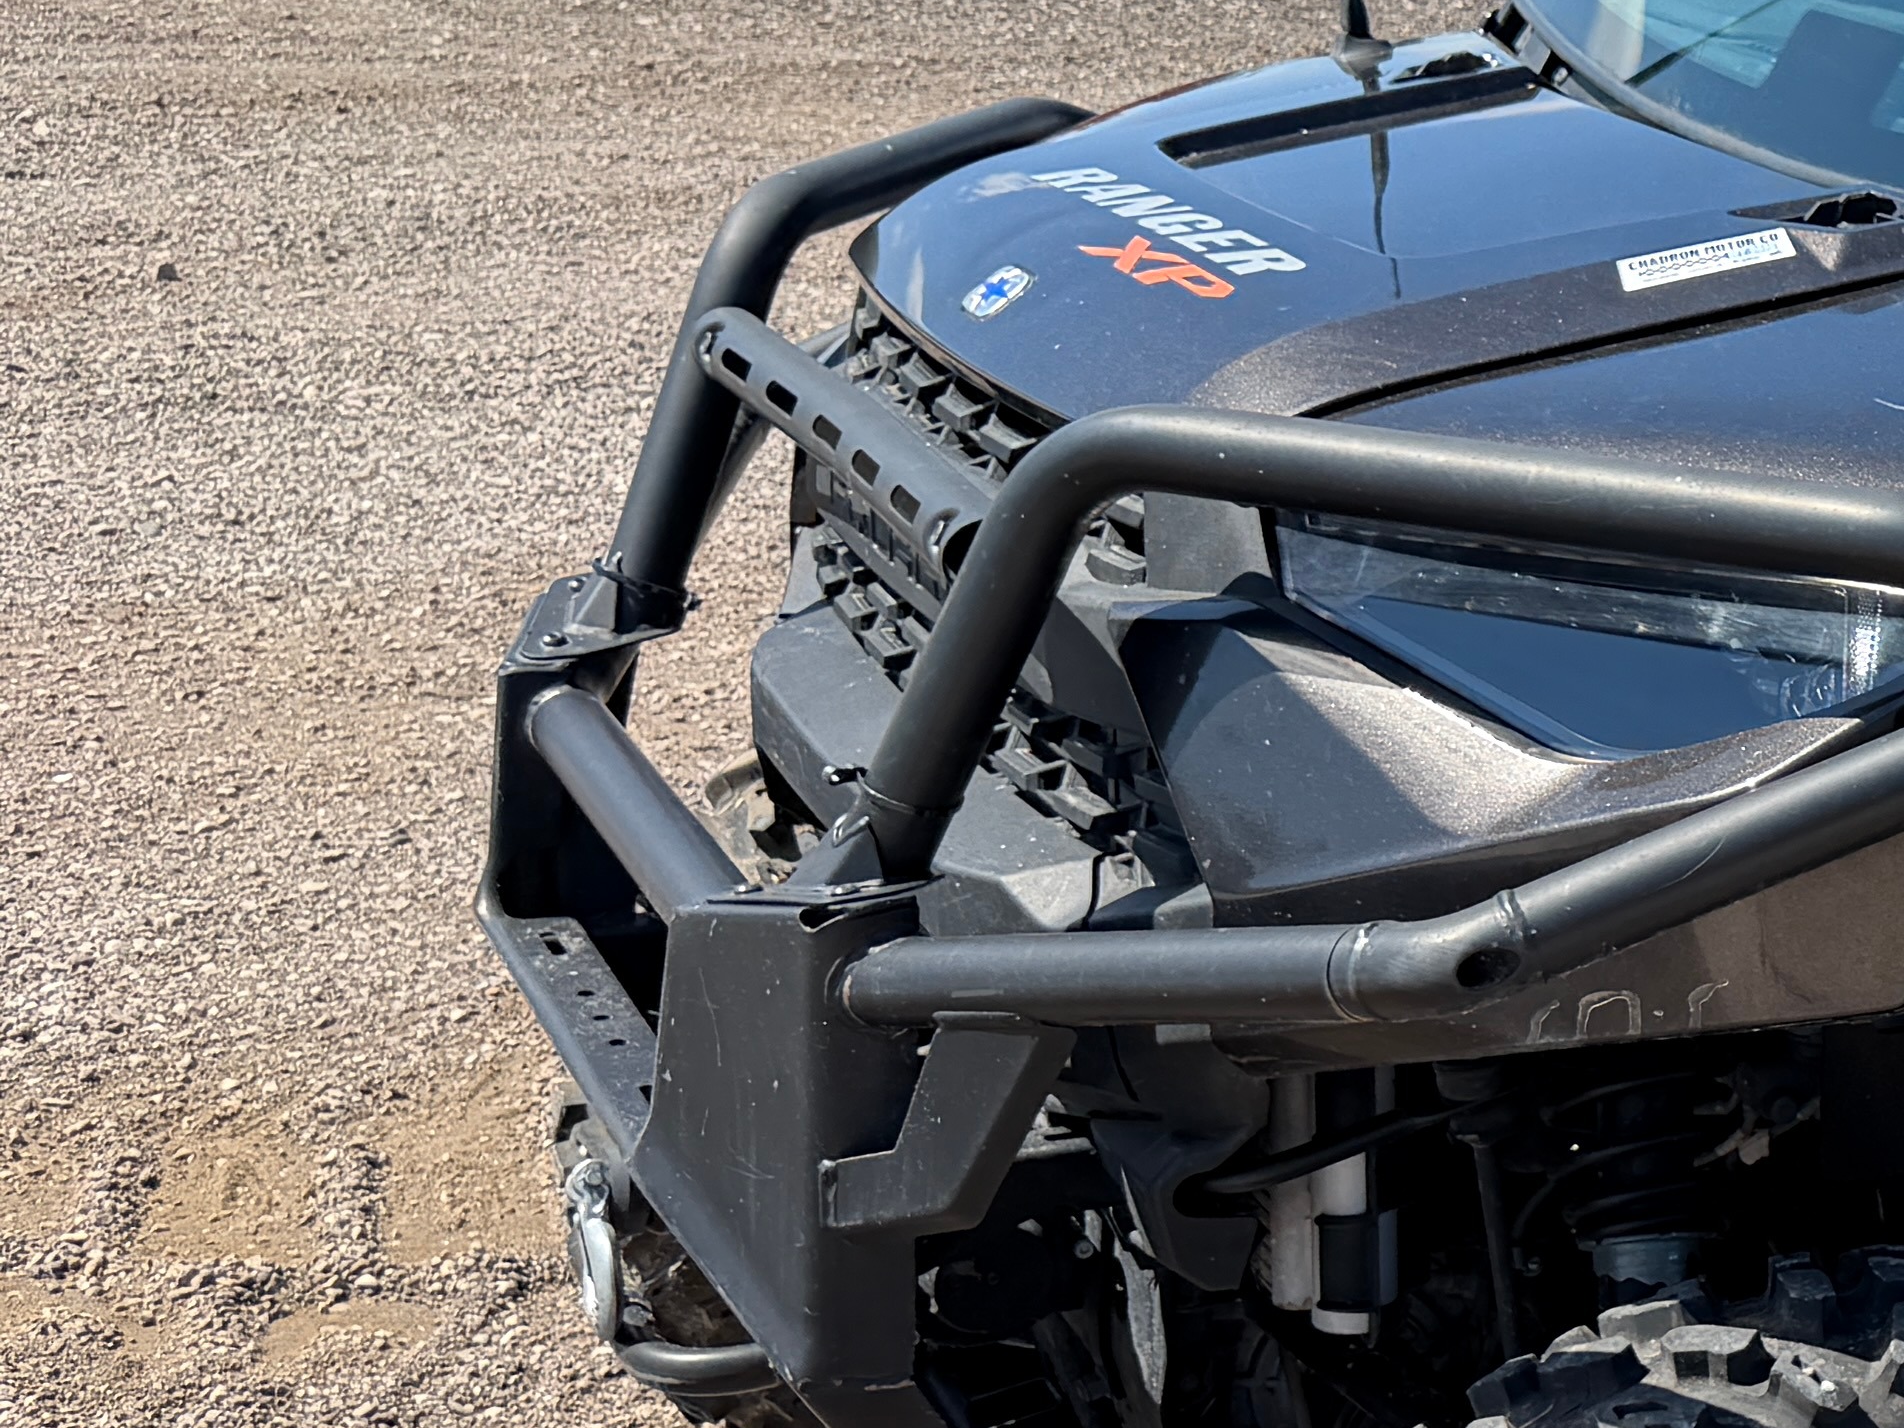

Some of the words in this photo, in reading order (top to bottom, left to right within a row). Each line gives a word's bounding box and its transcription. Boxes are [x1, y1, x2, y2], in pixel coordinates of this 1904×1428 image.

[1030, 167, 1307, 276] RANGER
[1628, 250, 1700, 271] CHADRON
[1704, 238, 1755, 255] MOTOR
[1759, 233, 1779, 245] CO
[1076, 235, 1236, 299] XP
